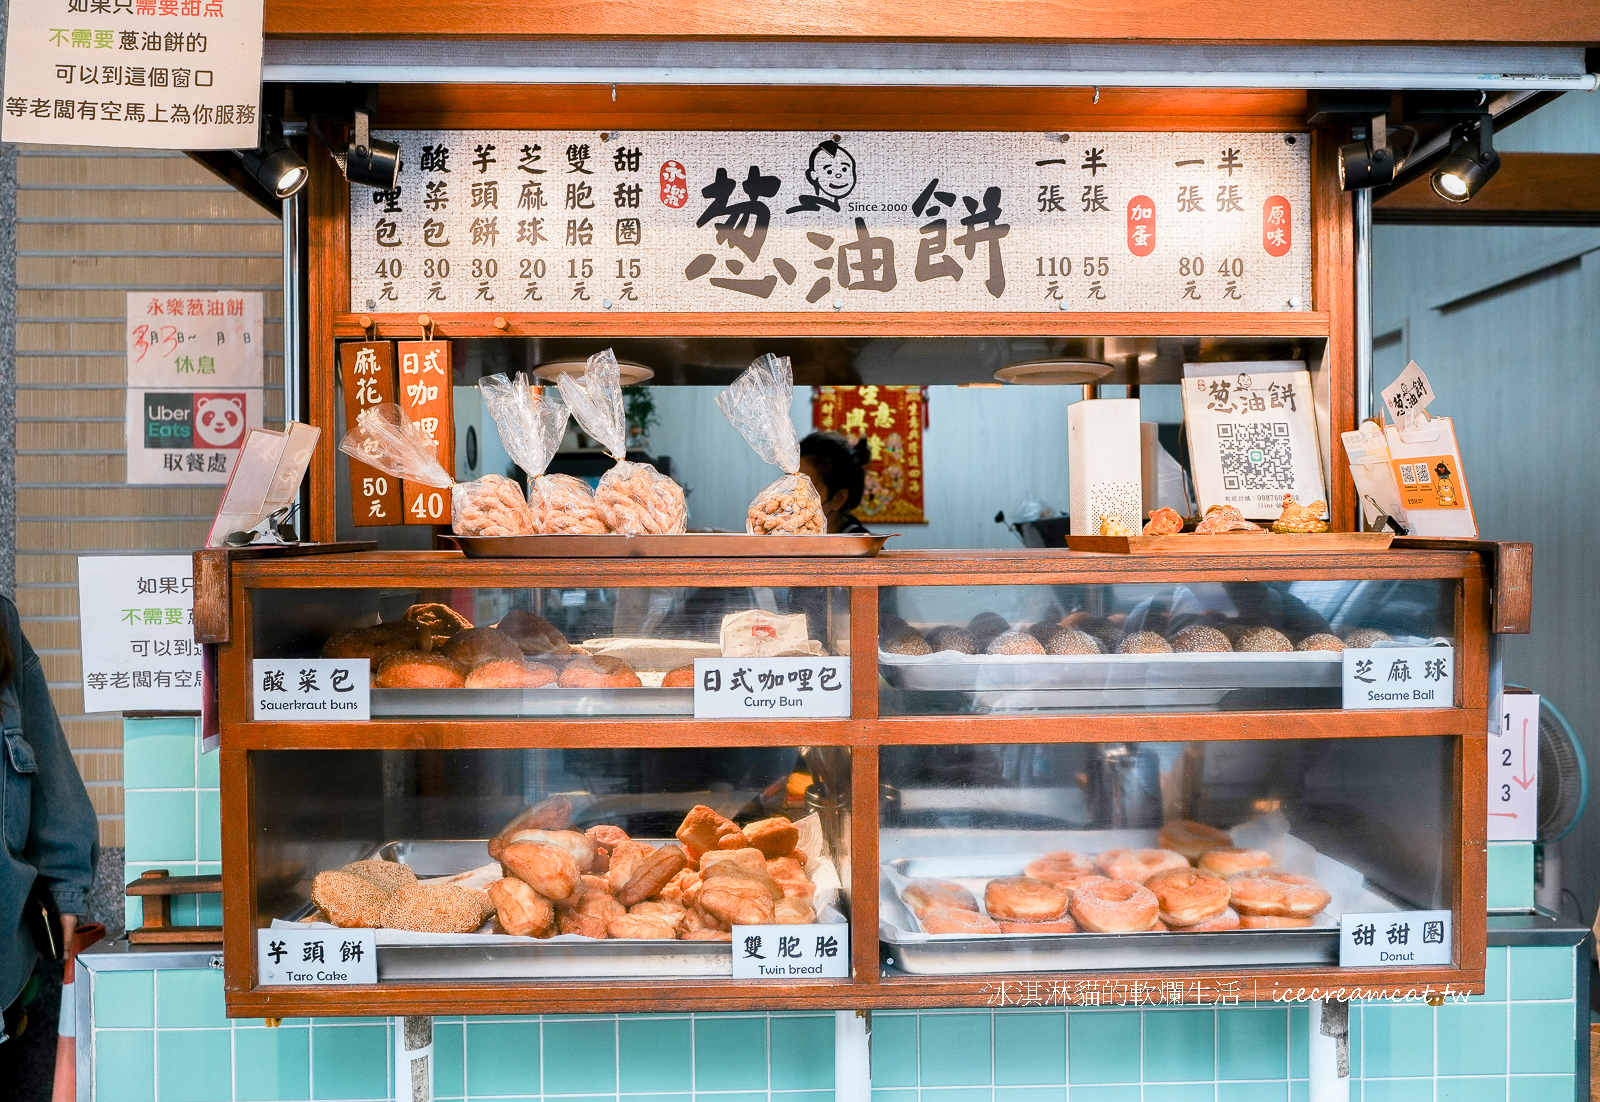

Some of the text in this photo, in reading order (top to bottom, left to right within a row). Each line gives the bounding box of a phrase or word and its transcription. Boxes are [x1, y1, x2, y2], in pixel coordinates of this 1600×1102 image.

[55, 64, 214, 88] 可以到這個窗口
[5, 96, 256, 125] 等老闆有空馬上為你服務
[1035, 158, 1067, 213] 一張
[1081, 147, 1111, 213] 半張
[1175, 158, 1205, 213] 一張
[1216, 147, 1245, 213] 半張
[420, 143, 451, 247] 酸菜包
[469, 143, 500, 247] 芋頭餅
[516, 143, 548, 247] 芝麻球
[565, 143, 594, 247] 雙胞胎
[613, 146, 643, 246] 甜甜圈
[848, 202, 908, 212] Since 2000
[1130, 203, 1152, 247] 加蛋
[1266, 205, 1288, 247] 原味
[175, 355, 216, 374] 休息
[148, 405, 191, 421] Uber
[148, 423, 191, 438] Eats
[163, 453, 227, 473] 取餐處
[411, 493, 444, 518] 40
[263, 668, 355, 693] 酸菜包
[703, 667, 842, 693] 日式咖哩包
[1353, 658, 1448, 683] 芝麻球
[260, 699, 358, 710] Sauerkraut buns
[744, 697, 803, 709] Curry Bun
[1367, 690, 1434, 701] Sesame Ball
[1503, 713, 1511, 730] 1
[1502, 749, 1512, 766] 2
[1501, 784, 1511, 801] 3
[1351, 920, 1445, 946] 甜甜圈
[267, 940, 364, 965] 芋頭餅
[742, 936, 838, 960] 雙胞胎
[1380, 951, 1415, 961] Donut
[286, 971, 348, 981] Taro Cake
[758, 964, 823, 975] Twin bread
